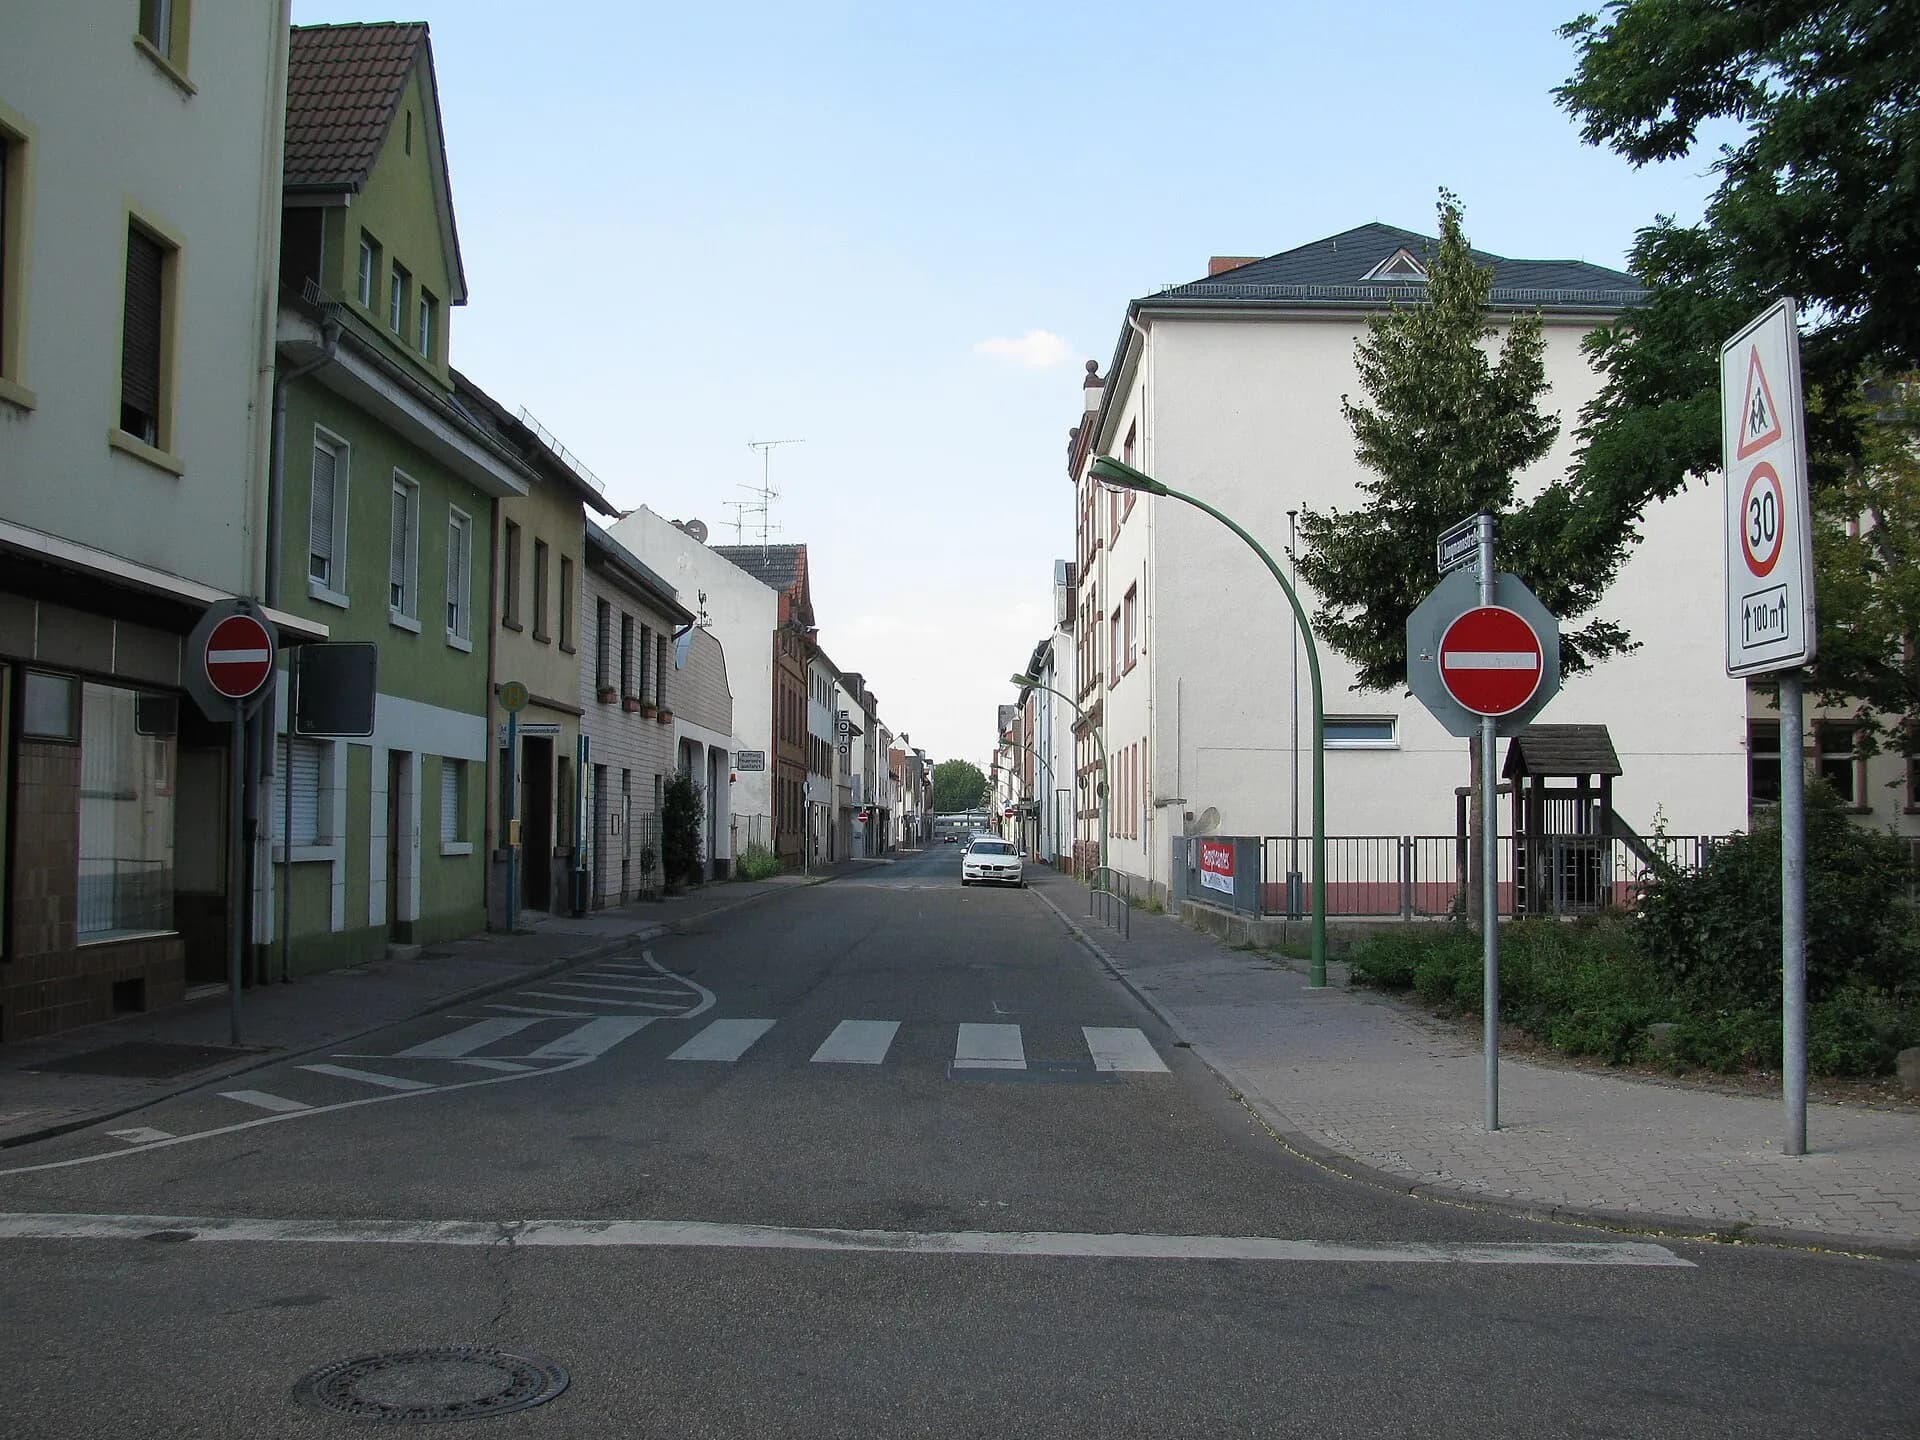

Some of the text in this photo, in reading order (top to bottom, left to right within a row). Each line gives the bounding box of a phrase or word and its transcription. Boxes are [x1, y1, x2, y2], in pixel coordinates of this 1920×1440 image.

[1750, 491, 1775, 547] 30
[1753, 603, 1778, 631] 100 m
[840, 711, 848, 753] FOTO
